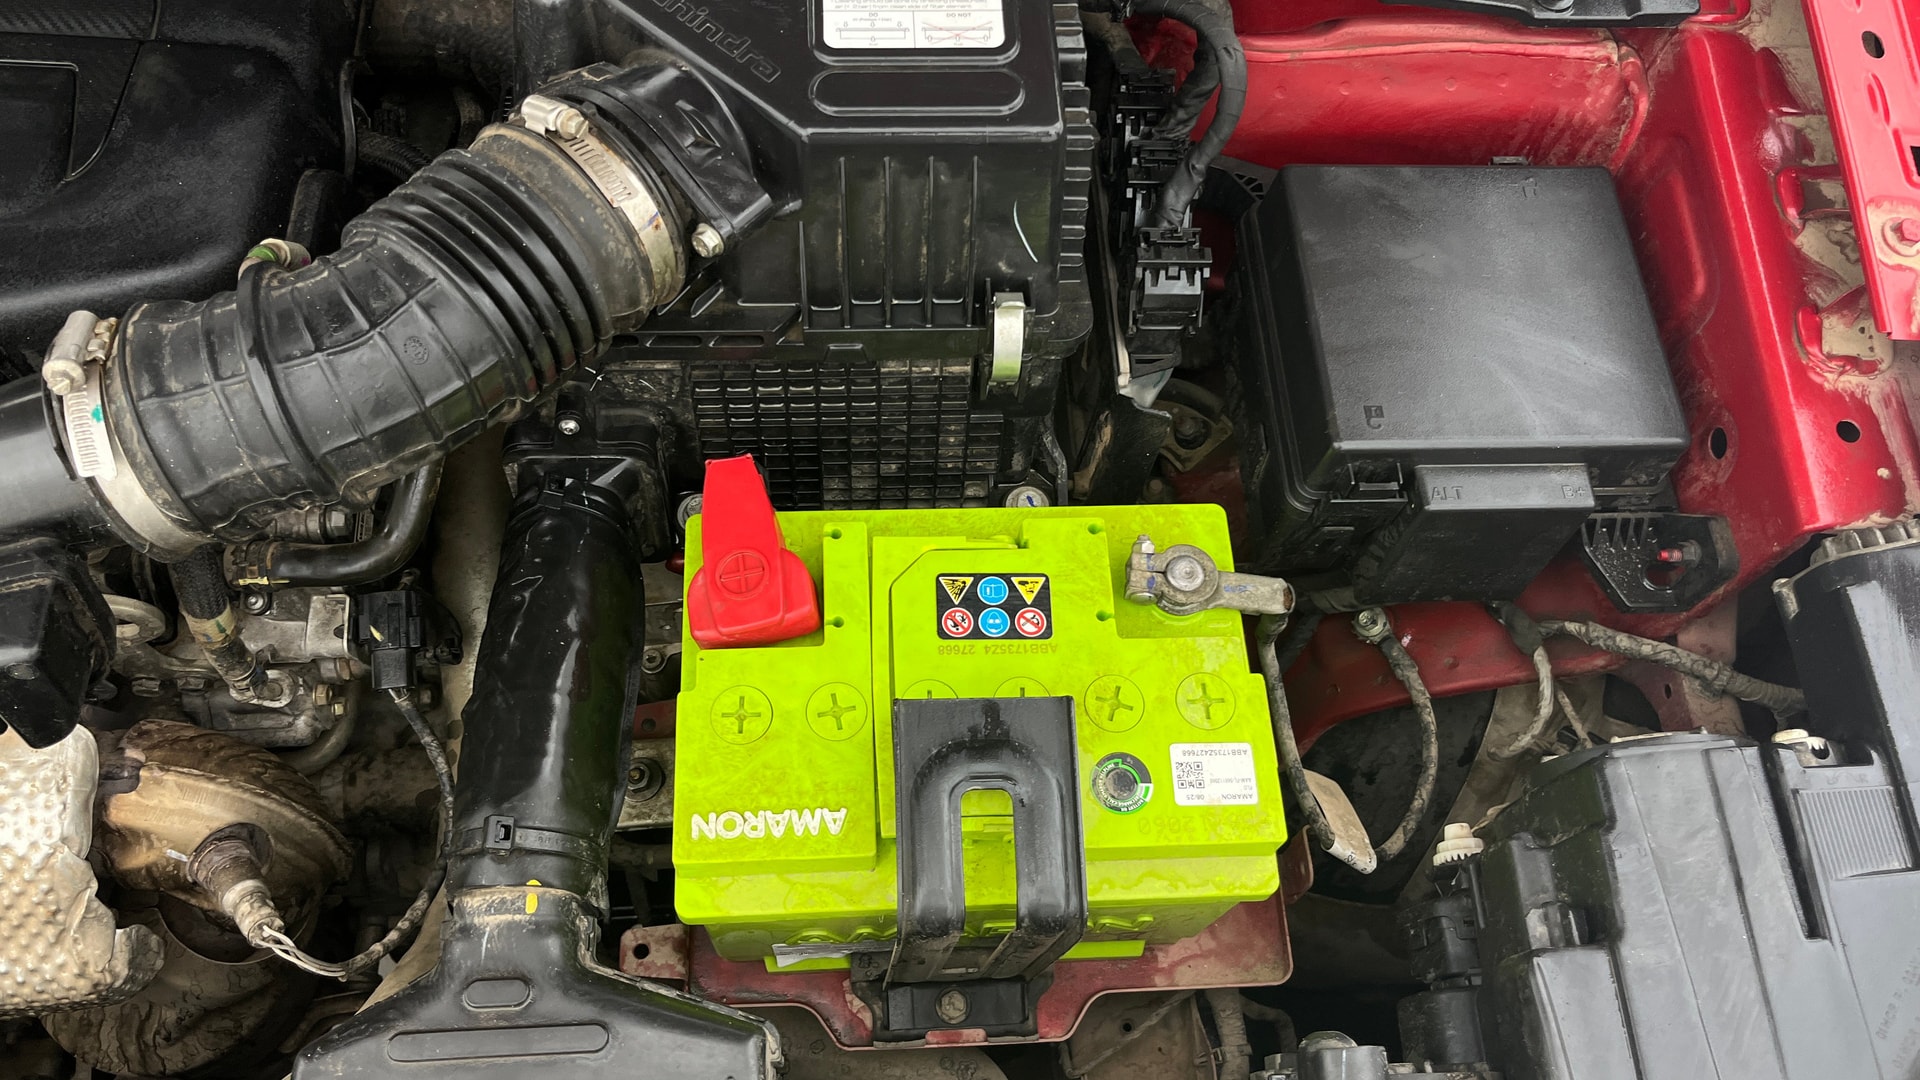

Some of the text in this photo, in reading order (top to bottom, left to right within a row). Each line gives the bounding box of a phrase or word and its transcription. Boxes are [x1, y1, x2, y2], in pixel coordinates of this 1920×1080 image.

[1431, 484, 1586, 501] ALT B+
[691, 807, 847, 840] AMARON
